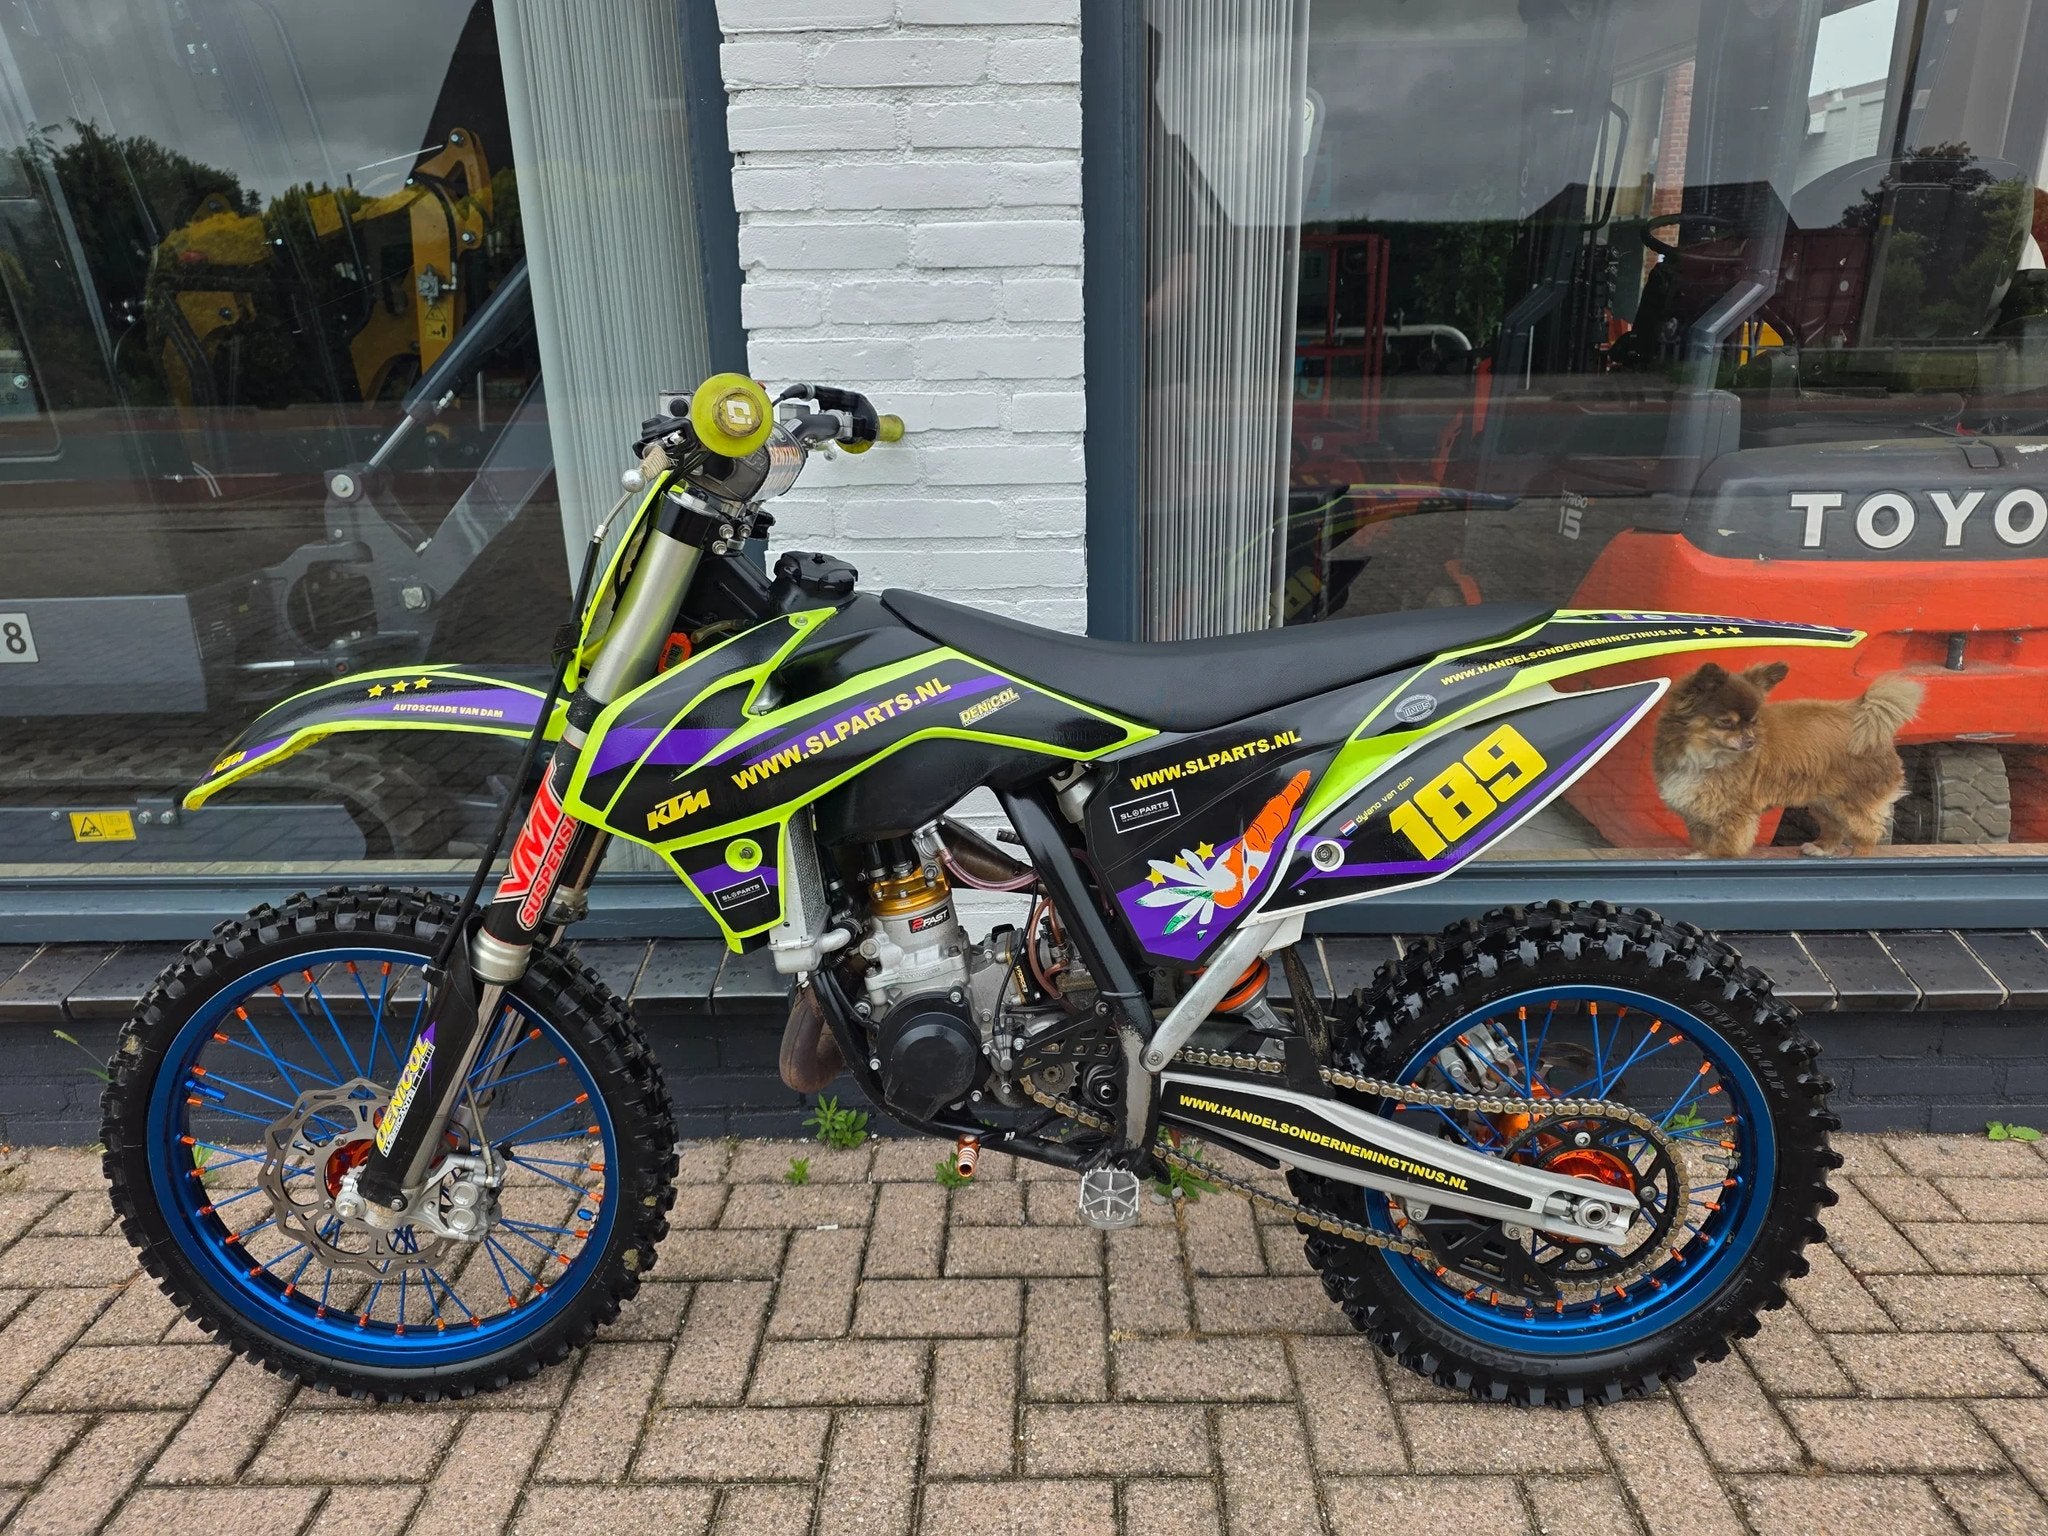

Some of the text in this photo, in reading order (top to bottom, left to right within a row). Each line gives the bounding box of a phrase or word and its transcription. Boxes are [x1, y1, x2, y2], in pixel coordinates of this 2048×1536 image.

[1558, 506, 1583, 540] 15
[1440, 628, 1687, 686] WWW.HANDELSONDERNEMINGTINUS.NL
[393, 704, 503, 718] AUTOSCHADE VAN DAM
[731, 677, 951, 790] WWW.SLPARTS.NL
[1130, 731, 1302, 791] WWW.SLPARTS.NL
[647, 789, 711, 831] KTM
[1389, 724, 1547, 861] 189
[522, 815, 577, 926] SUSPENSI
[912, 909, 948, 930] 2FAST
[1180, 1094, 1469, 1191] WWW.HANDELSONDERNEMINGTINUS.NL
